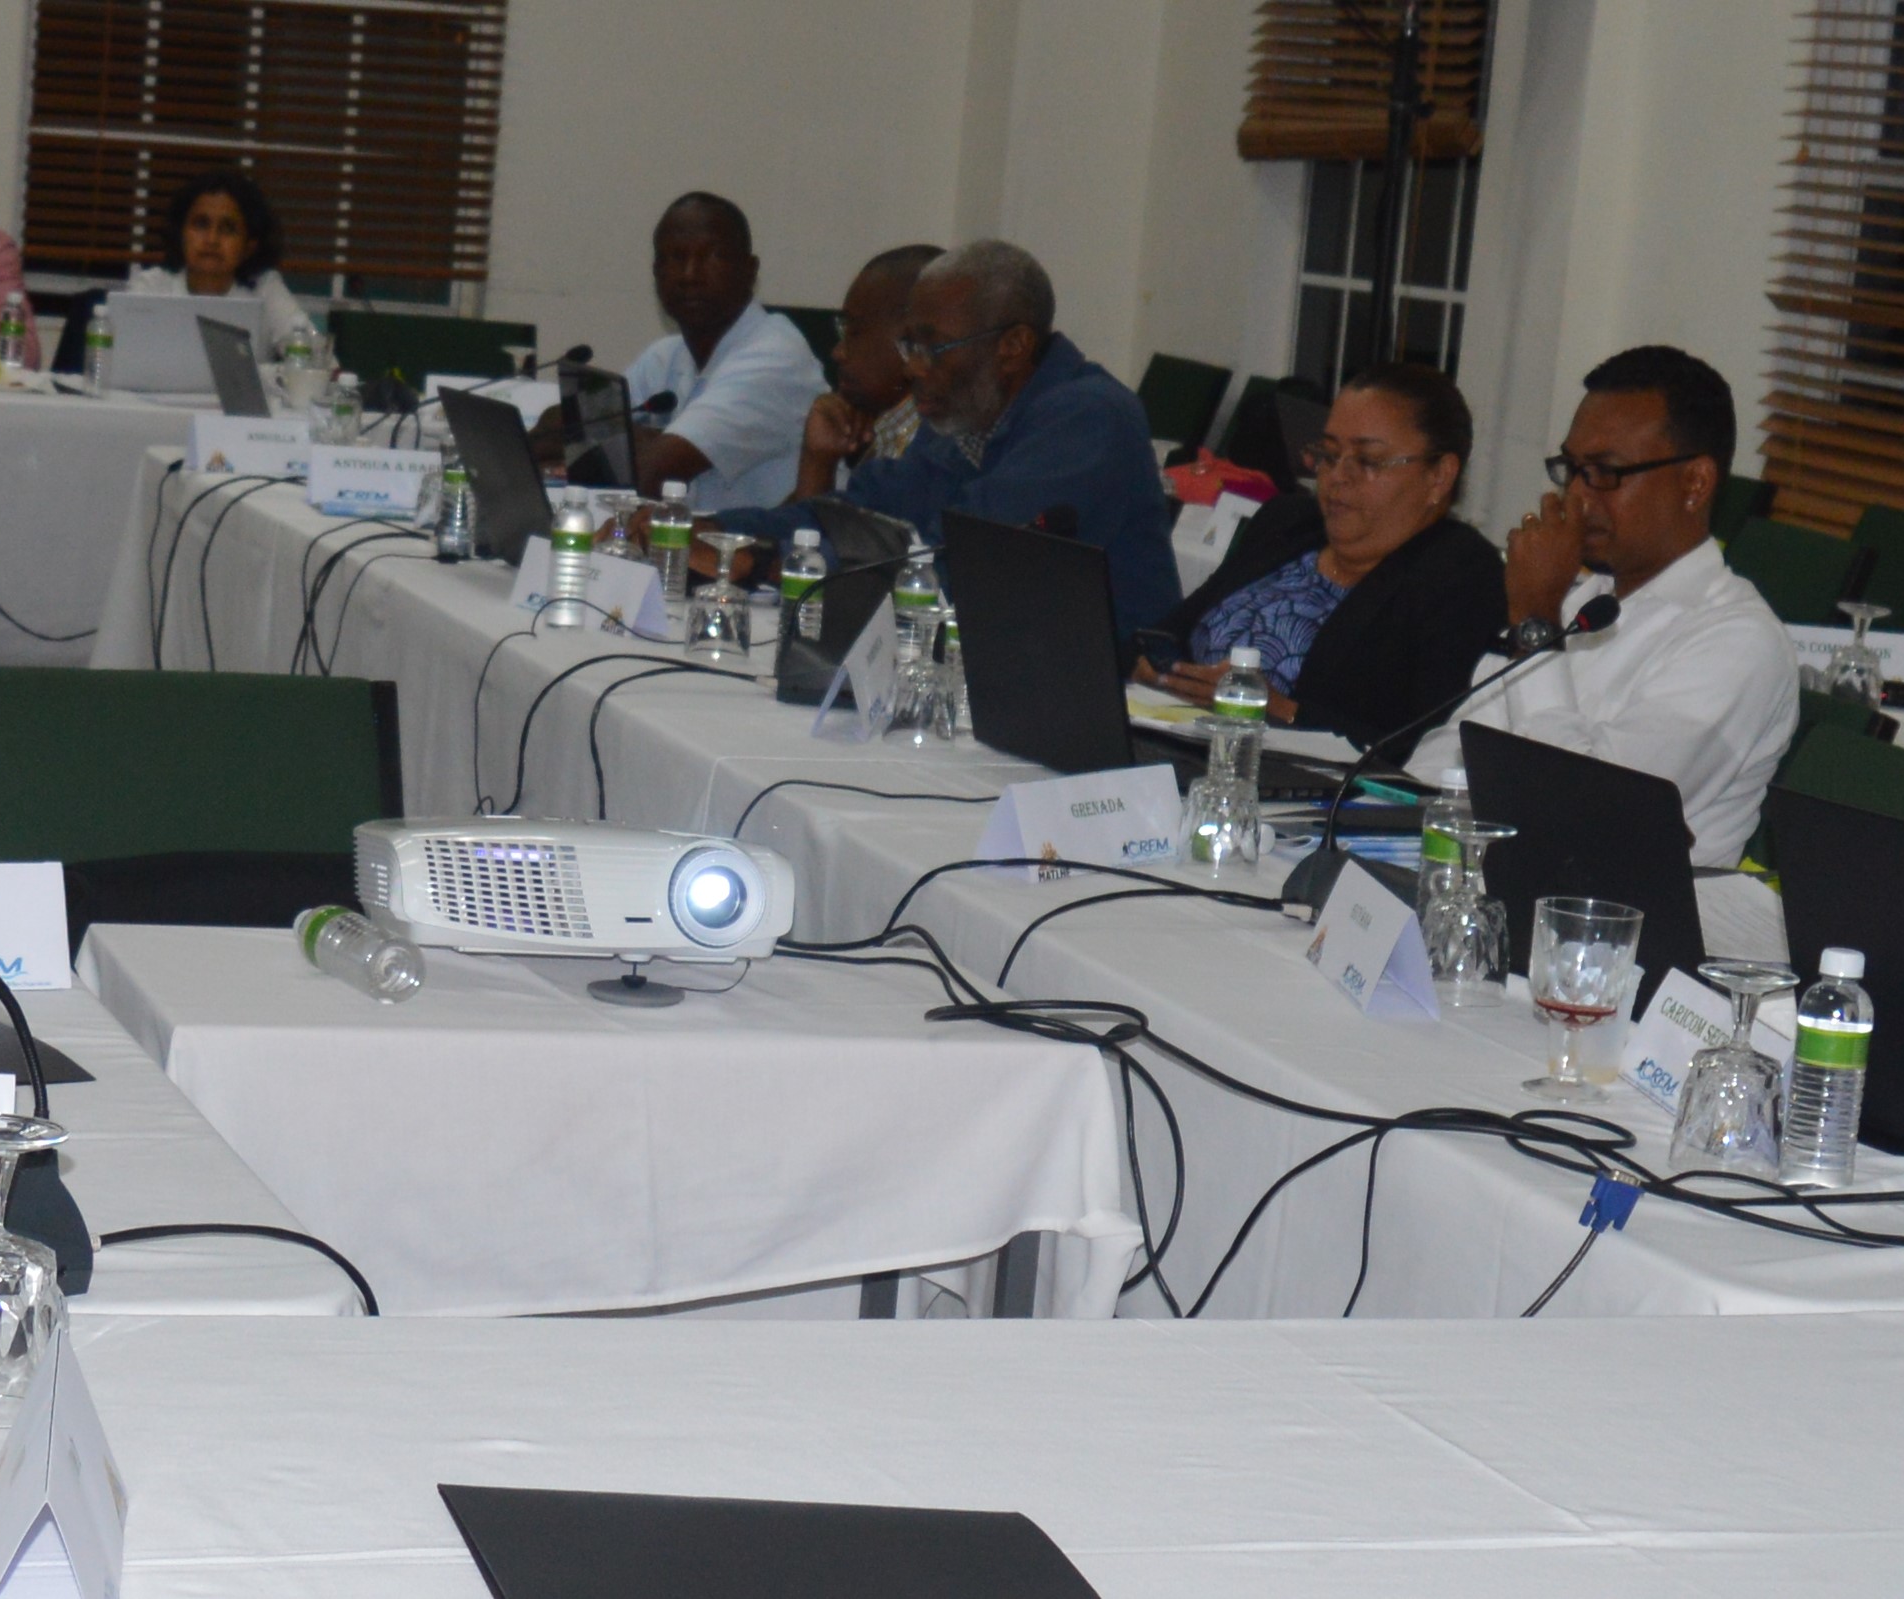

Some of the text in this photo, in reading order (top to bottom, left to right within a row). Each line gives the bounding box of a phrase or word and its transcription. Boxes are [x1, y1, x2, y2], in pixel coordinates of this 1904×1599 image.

[334, 459, 390, 470] ANTIGUA
[1070, 797, 1126, 819] GRENADA
[1124, 837, 1170, 857] CRFM
[1660, 996, 1708, 1039] CARICOM
[1638, 1058, 1680, 1096] CRFM
